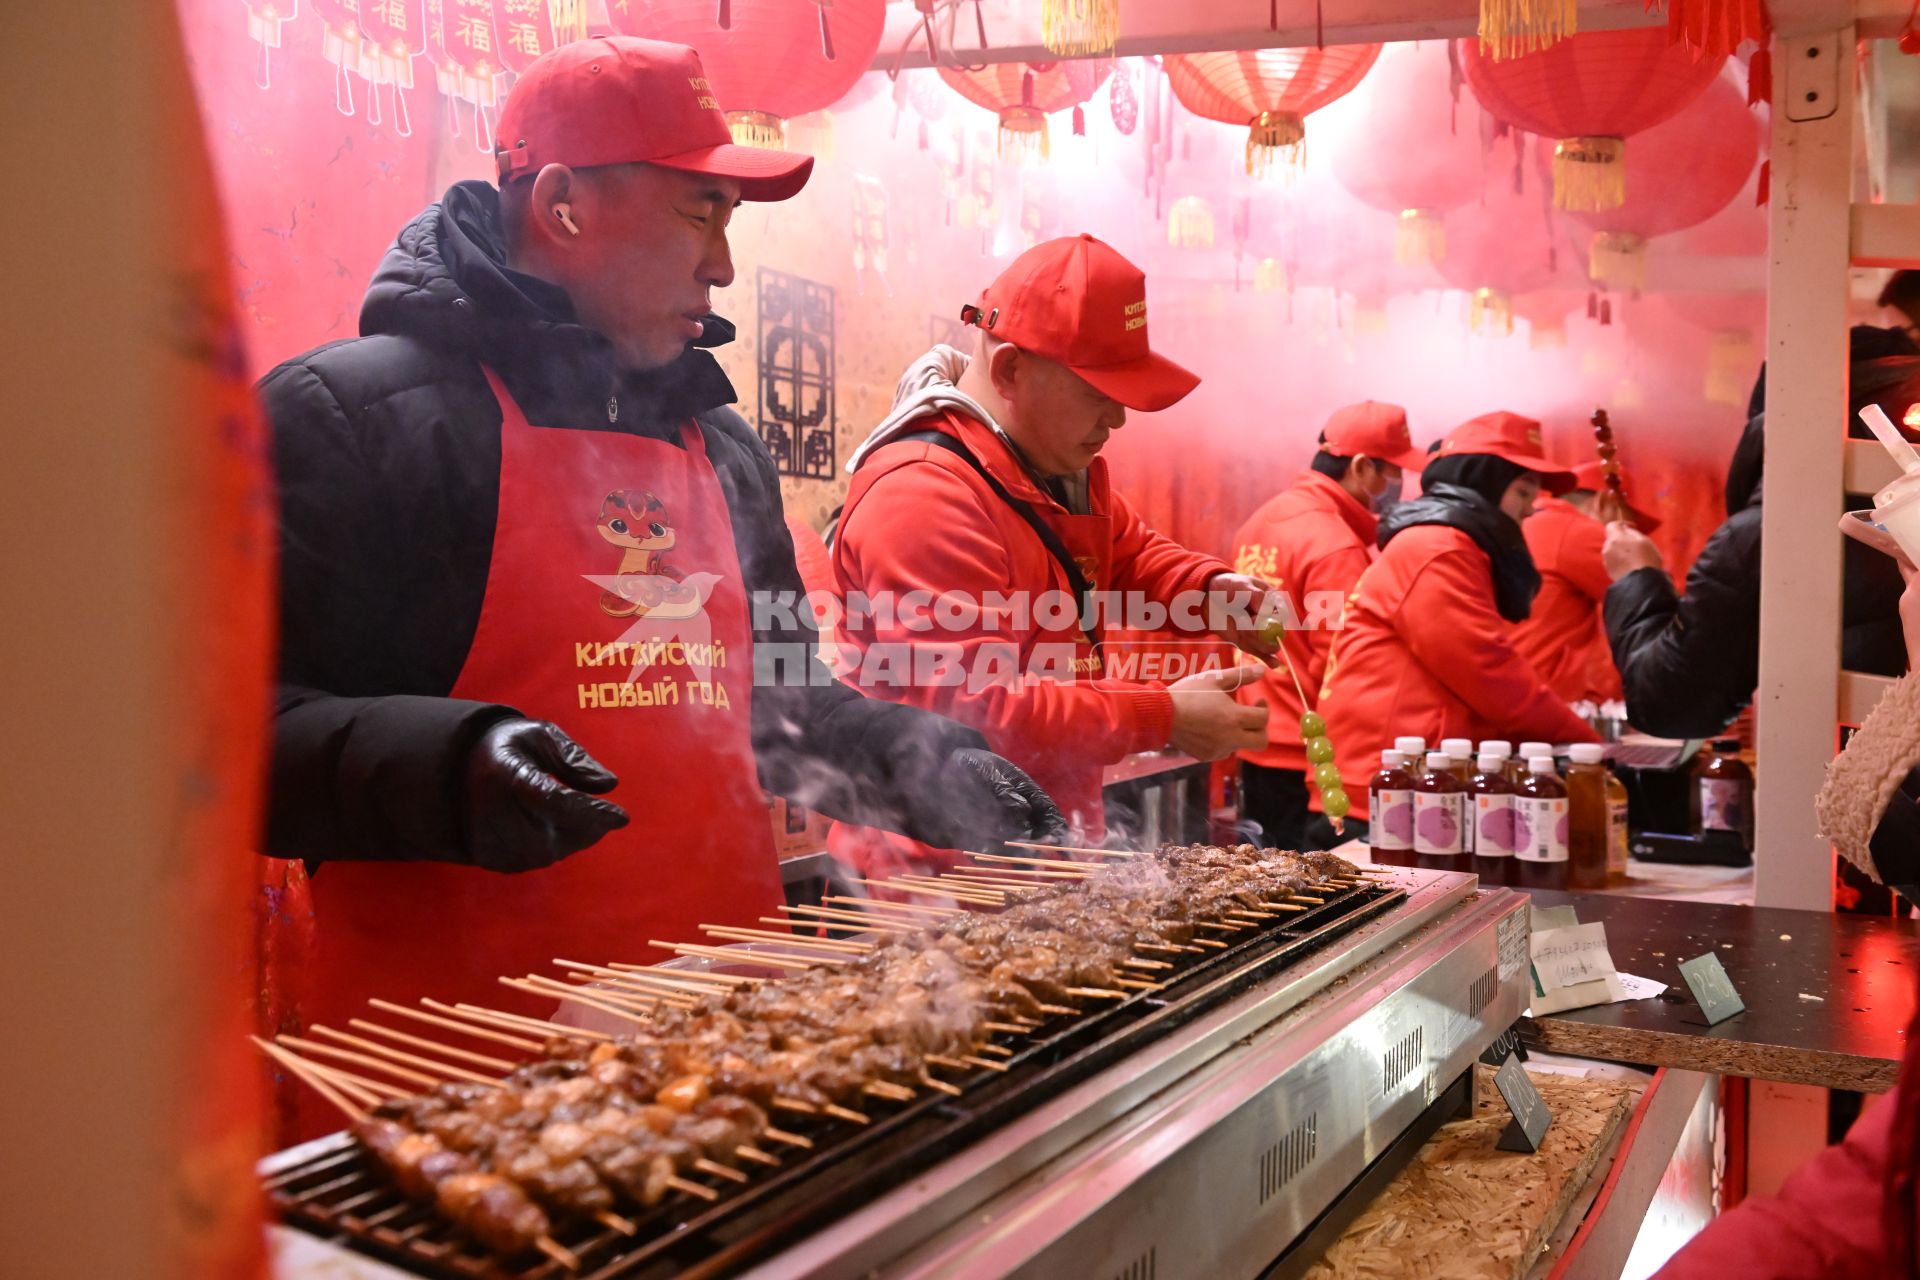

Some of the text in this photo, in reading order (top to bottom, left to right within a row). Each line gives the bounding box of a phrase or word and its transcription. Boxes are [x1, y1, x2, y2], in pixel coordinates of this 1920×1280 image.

[455, 14, 491, 53] 福
[508, 21, 542, 57] 福
[575, 636, 726, 668] КИТАЙСКИЙ
[577, 675, 731, 711] НОВЫЙ ГОД
